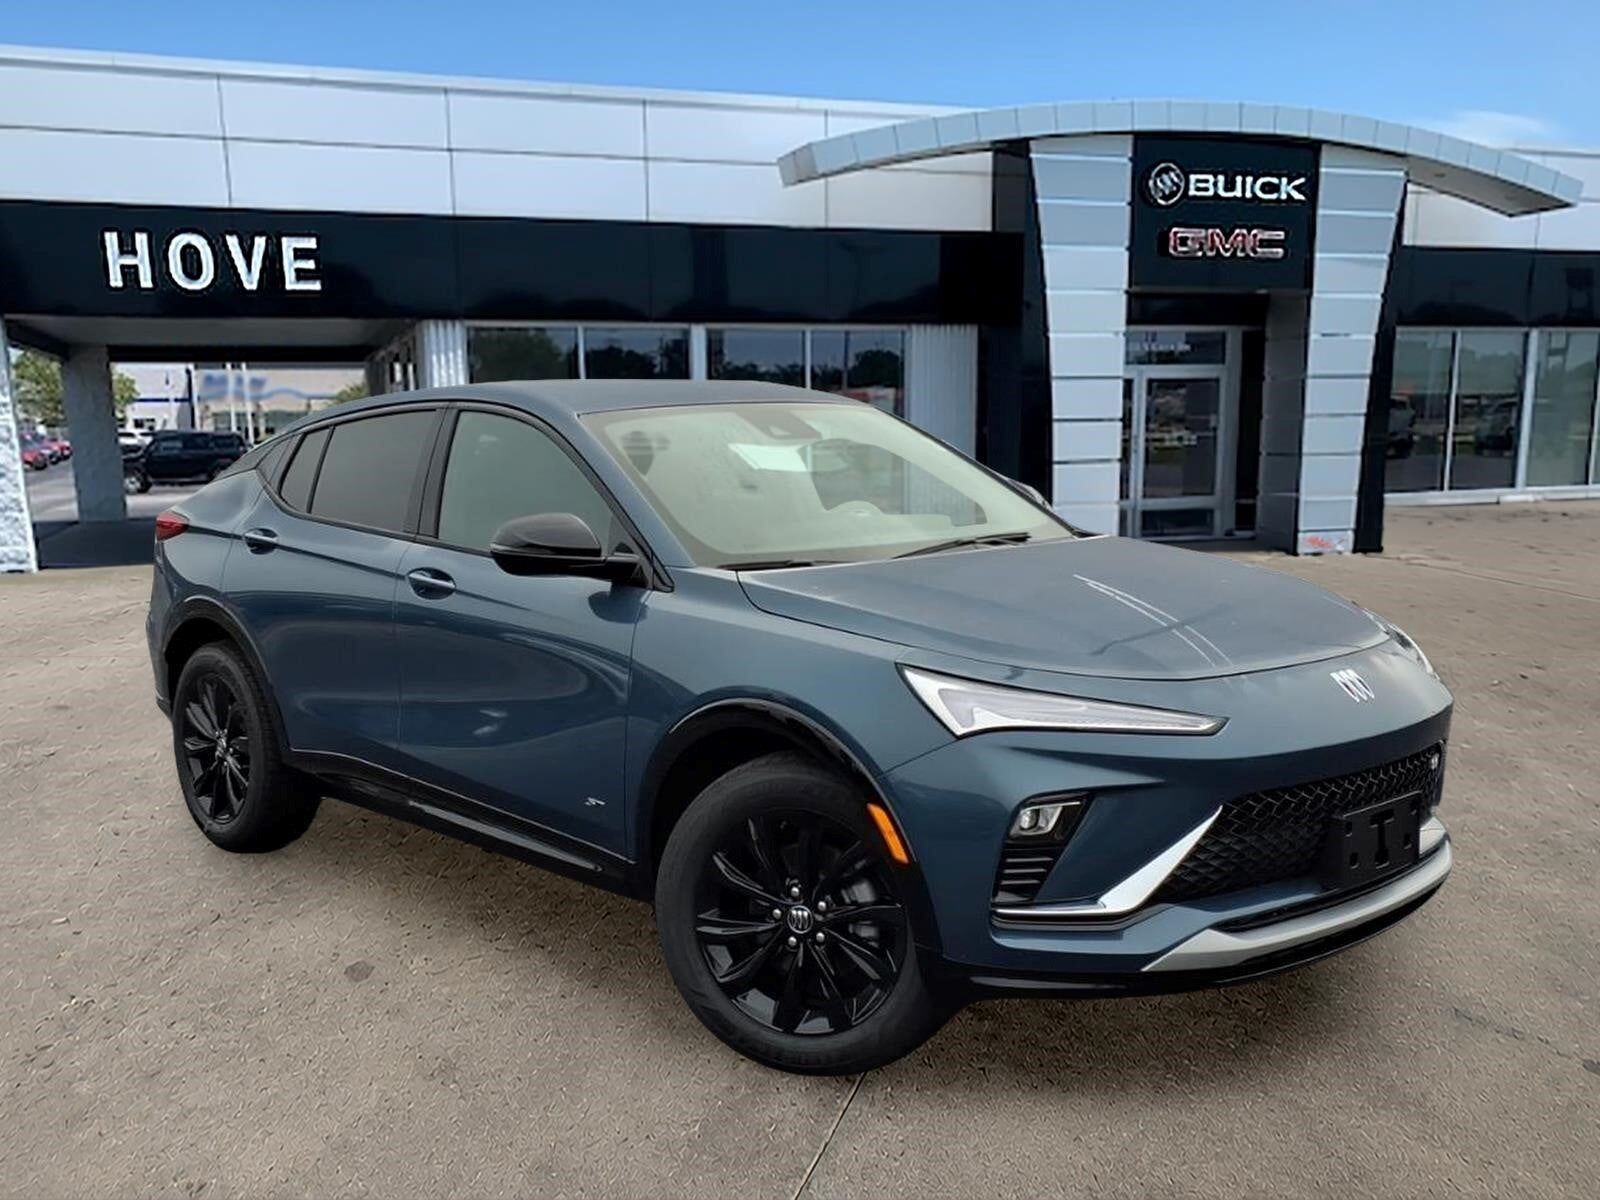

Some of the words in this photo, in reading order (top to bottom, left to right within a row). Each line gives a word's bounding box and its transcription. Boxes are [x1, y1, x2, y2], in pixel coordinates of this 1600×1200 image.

[1188, 174, 1307, 200] BUICK
[1168, 227, 1285, 258] GMC
[103, 231, 322, 291] HOVE
